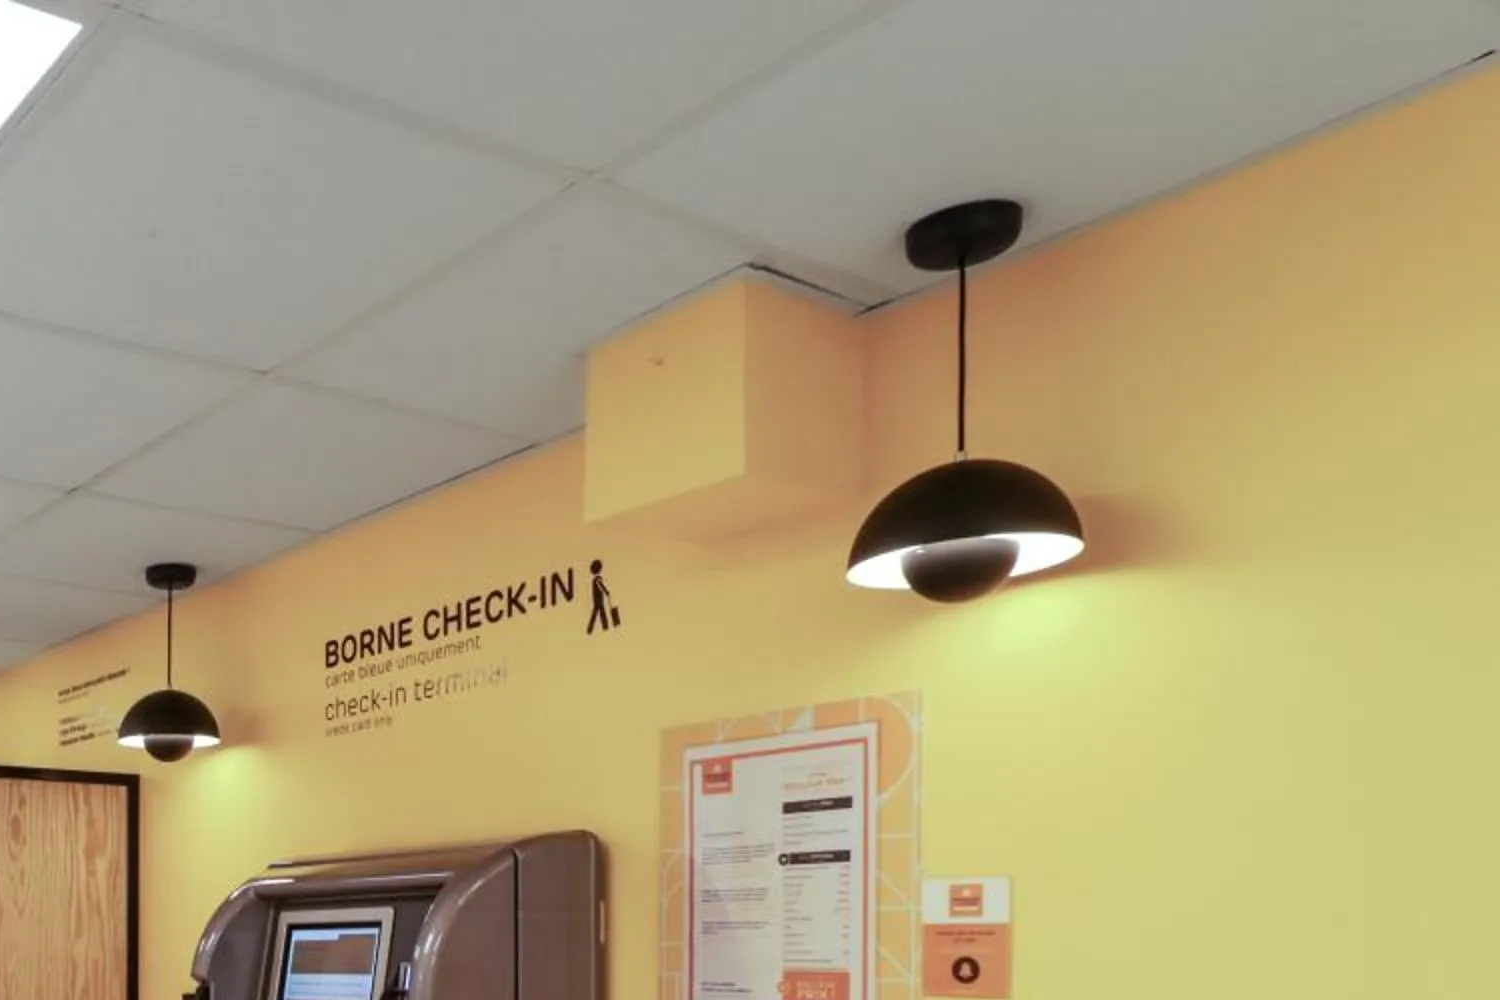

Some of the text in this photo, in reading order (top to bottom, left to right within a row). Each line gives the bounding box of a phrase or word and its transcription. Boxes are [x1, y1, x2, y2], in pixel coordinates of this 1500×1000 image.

[325, 568, 575, 668] BORNE CHECK-IN
[325, 635, 481, 689] carte bleue uniquement
[325, 655, 507, 721] check-in terminal
